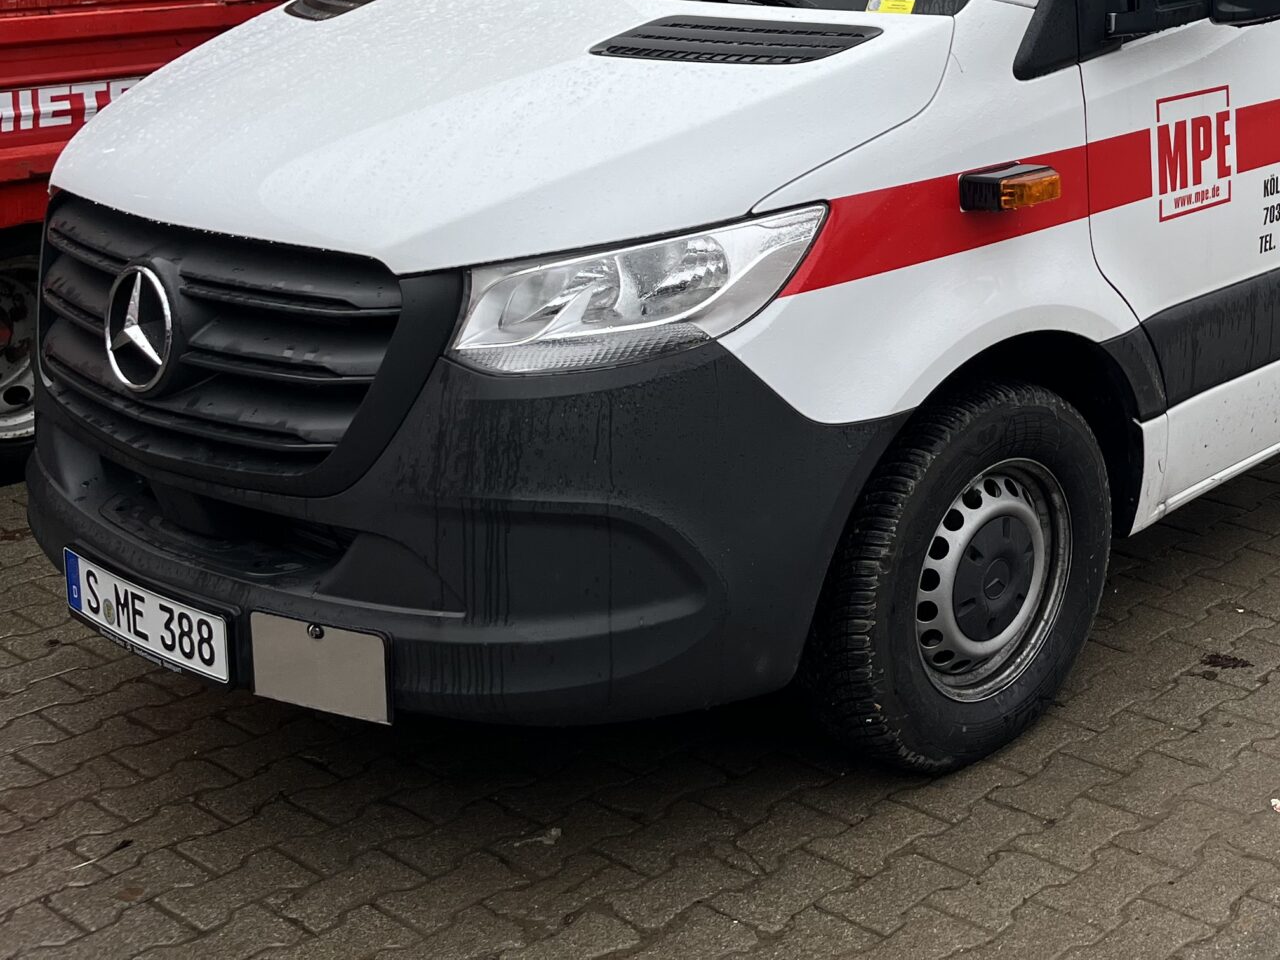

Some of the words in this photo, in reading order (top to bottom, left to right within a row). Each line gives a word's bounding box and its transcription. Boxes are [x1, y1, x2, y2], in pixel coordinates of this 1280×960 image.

[1157, 110, 1231, 195] MPE
[1174, 184, 1220, 209] www.mpe.de
[1259, 235, 1276, 254] TEL.
[72, 585, 78, 598] D
[86, 569, 101, 616] S
[114, 583, 149, 642] ME
[159, 604, 215, 667] 388
